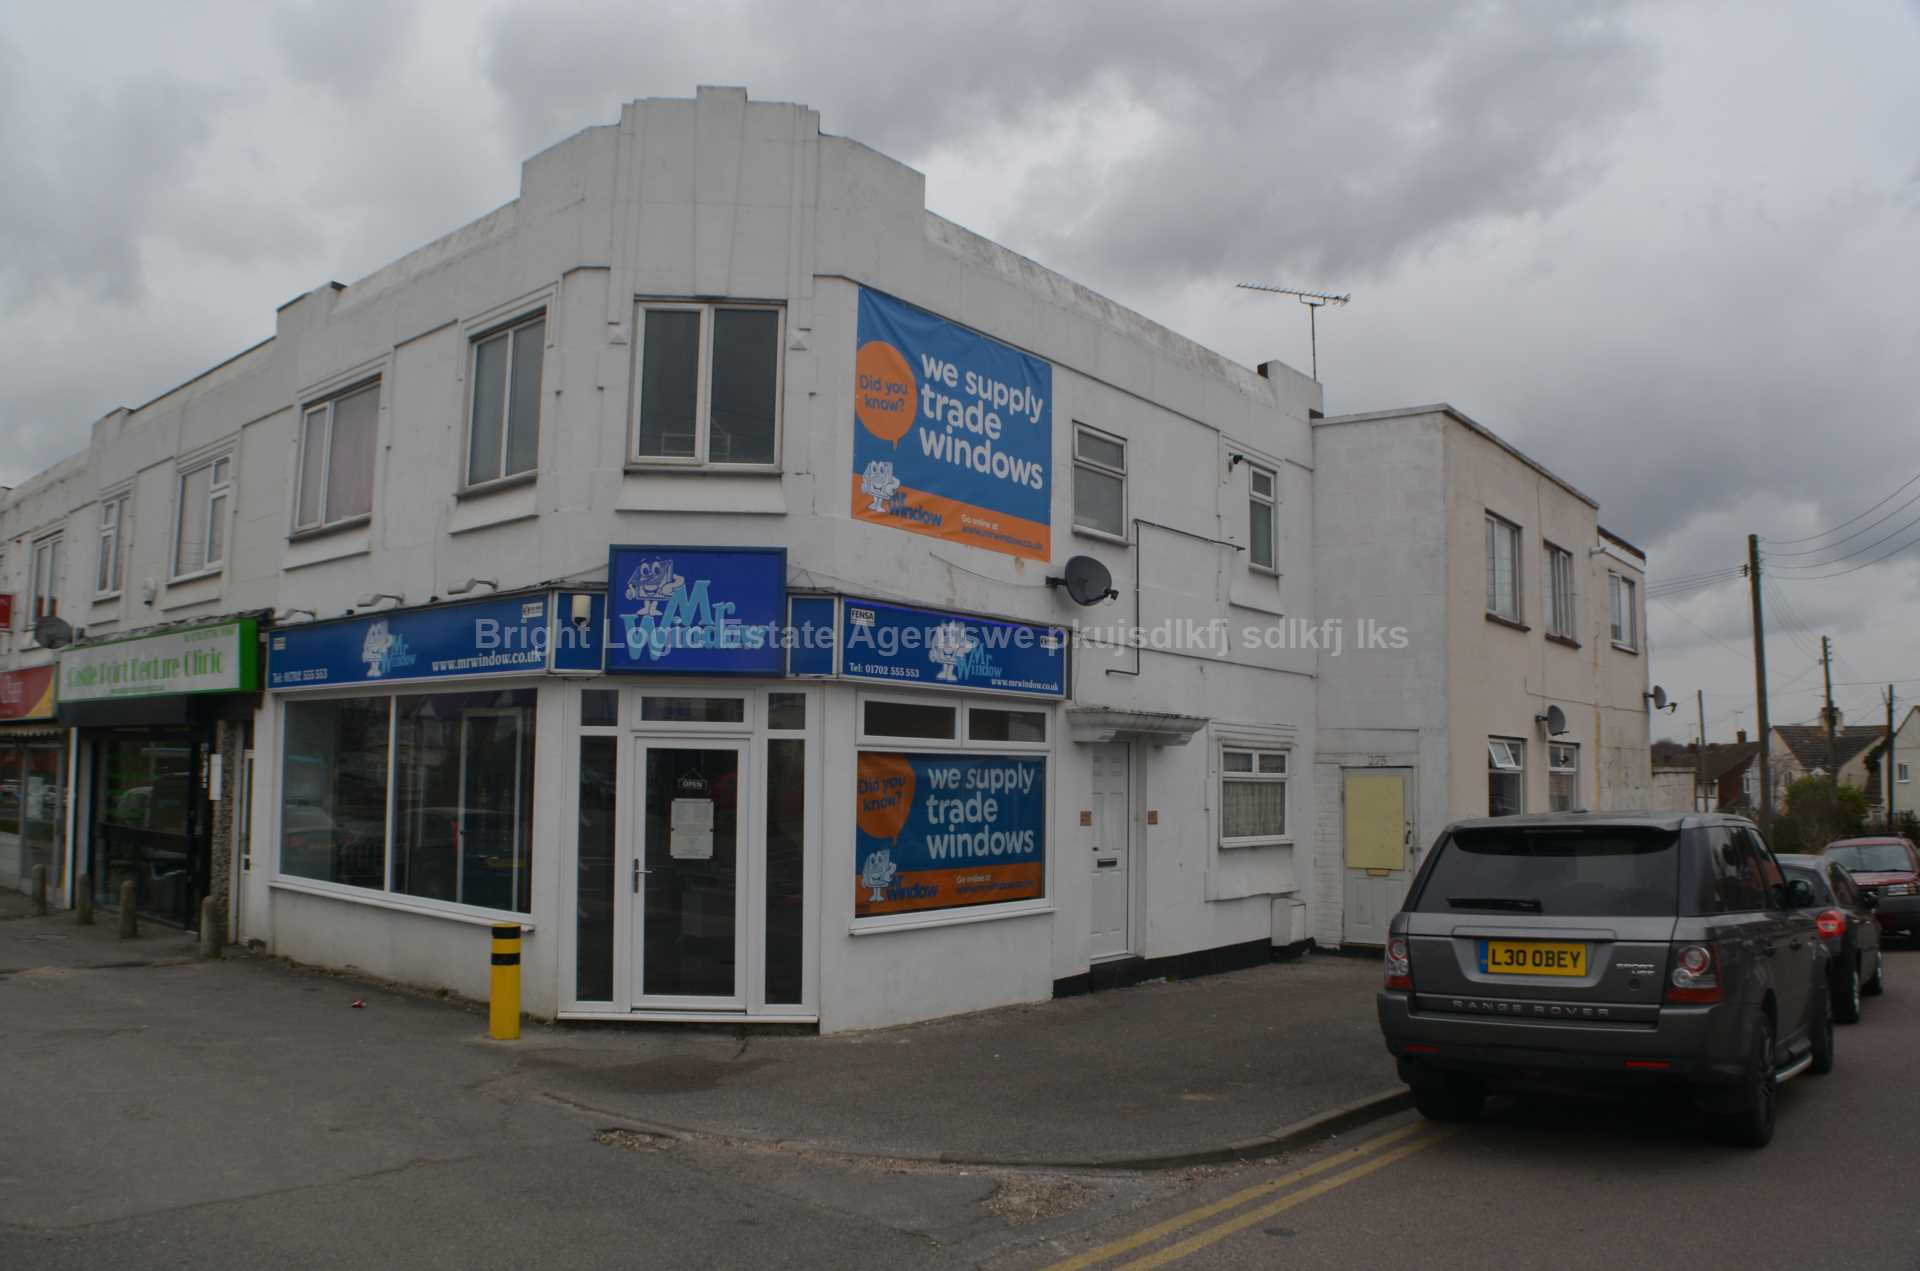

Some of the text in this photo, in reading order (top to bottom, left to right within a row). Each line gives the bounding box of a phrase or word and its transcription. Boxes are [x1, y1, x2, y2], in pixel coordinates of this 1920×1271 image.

[859, 374, 908, 400] Did you
[921, 353, 1043, 424] we supply
[864, 394, 905, 412] know?
[921, 382, 1002, 440] trade
[919, 425, 1043, 491] windows
[660, 579, 736, 626] Mr
[851, 609, 875, 621] FENSA
[183, 648, 224, 676] Clinic
[432, 648, 542, 672] www.mrwindow.co.uk
[968, 641, 993, 666] Mr
[849, 662, 920, 680] Tel: 01702 555 553
[955, 655, 1003, 681] Window
[682, 780, 704, 789] OPEN
[927, 762, 1036, 795] we supply
[926, 791, 999, 825] trade
[926, 824, 1035, 860] windows
[1491, 948, 1527, 966] L30
[1451, 999, 1609, 1017] RANGE ROVER
